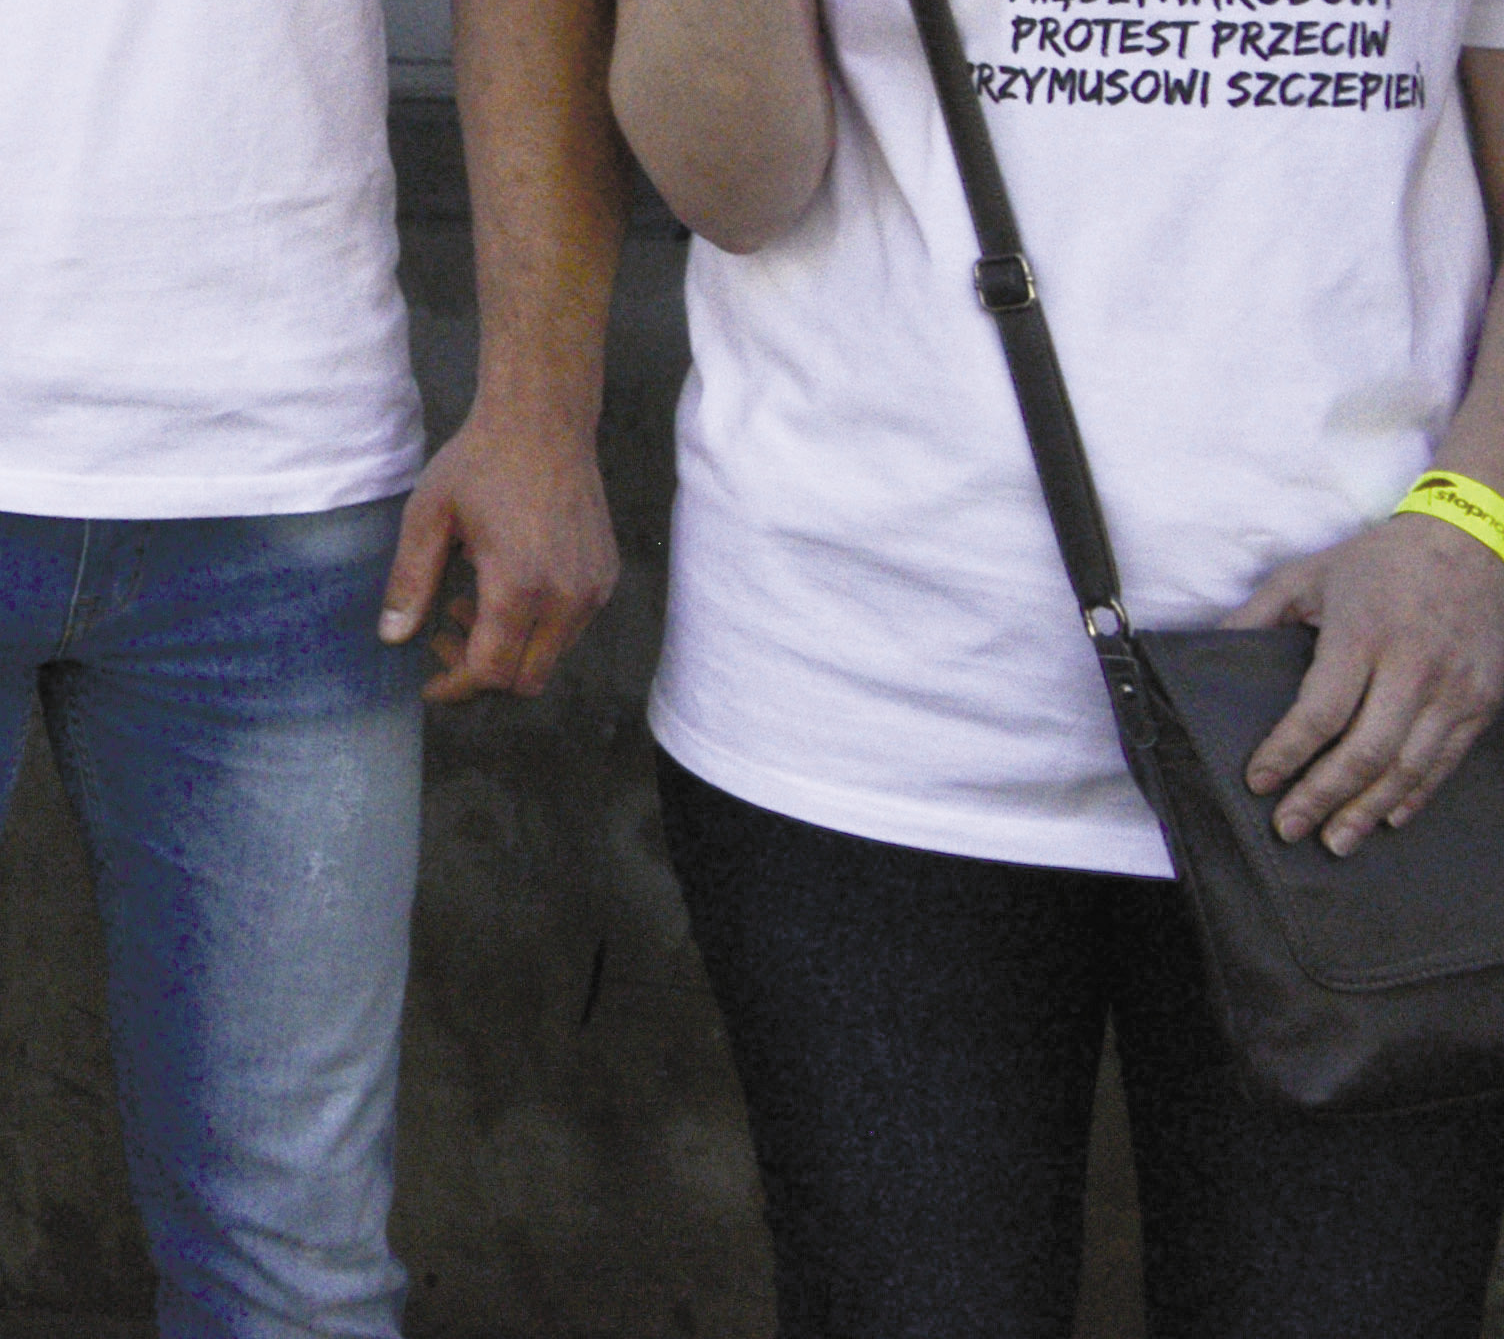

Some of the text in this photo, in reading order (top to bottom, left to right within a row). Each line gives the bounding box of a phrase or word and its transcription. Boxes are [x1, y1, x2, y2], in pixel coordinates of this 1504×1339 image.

[1011, 16, 1390, 61] PROTEST PRZECIW
[1227, 62, 1425, 111] SZCZEPIEŃ
